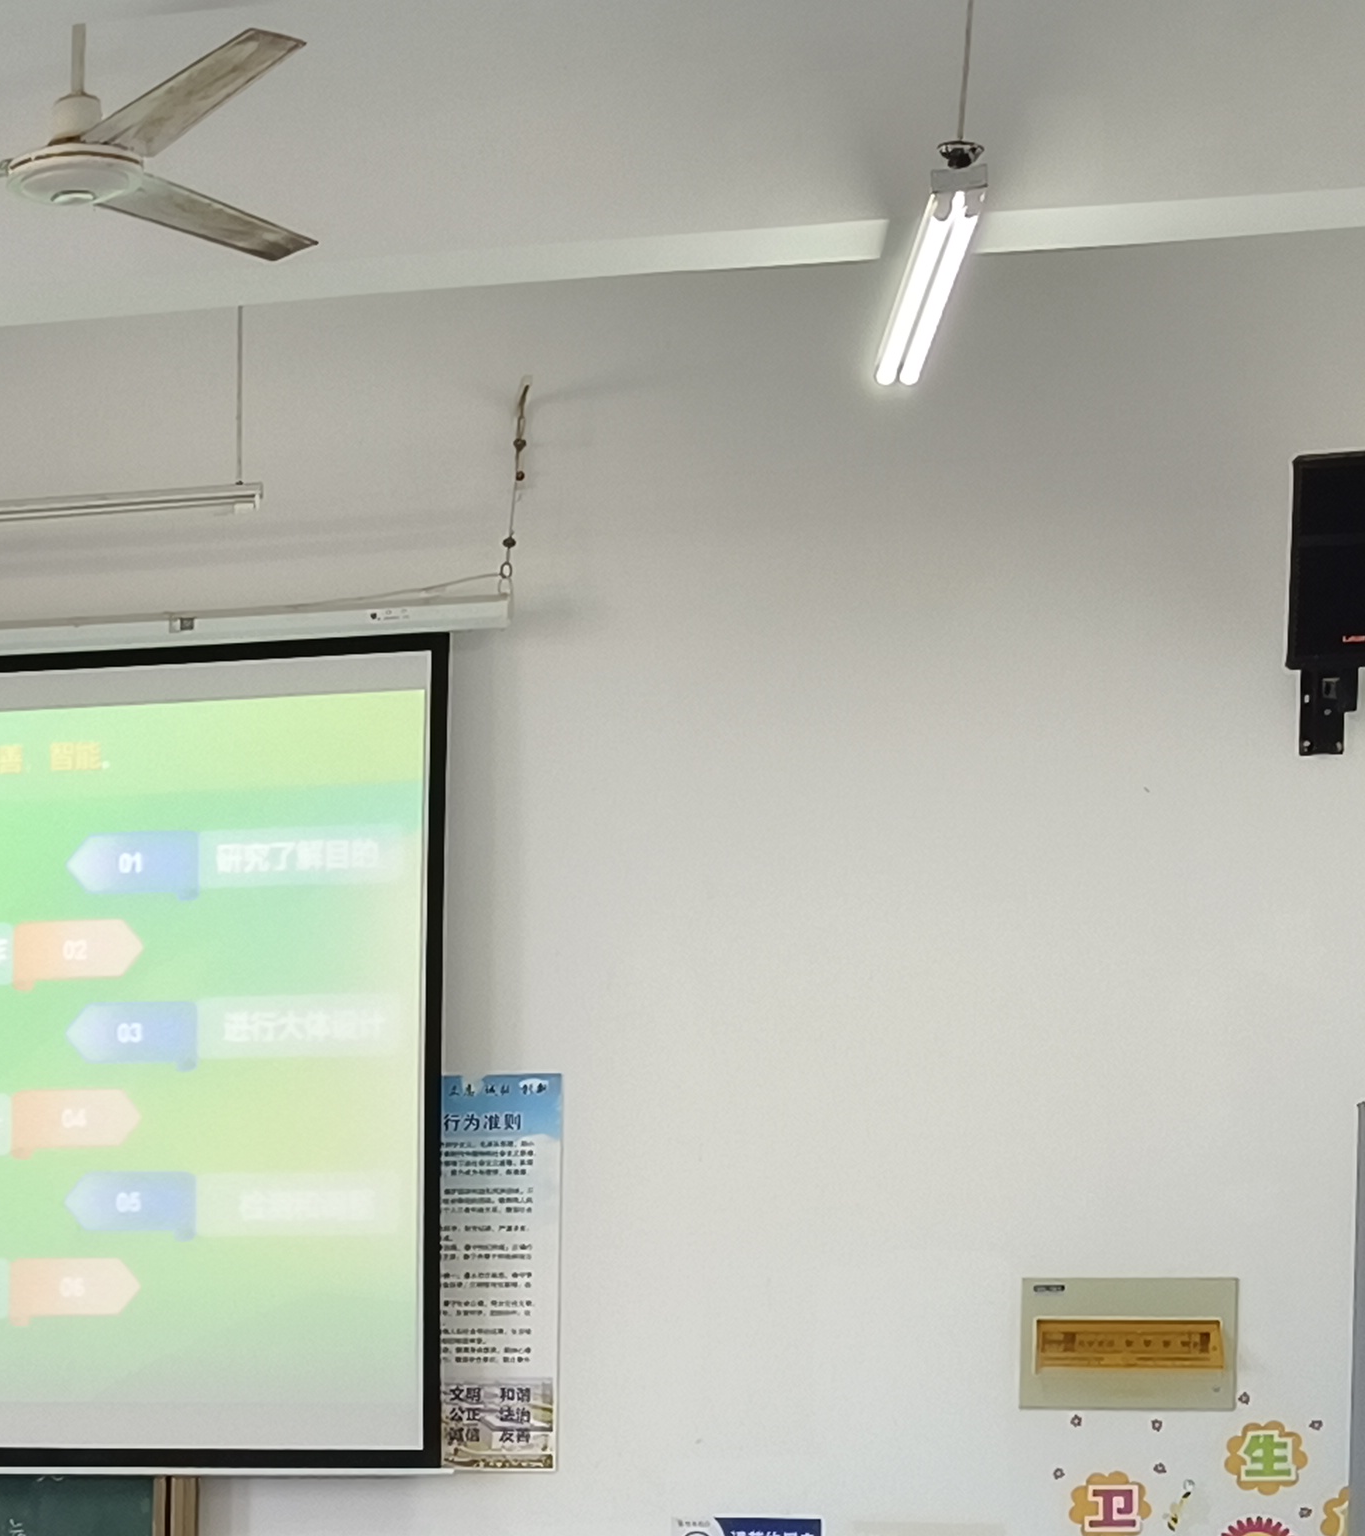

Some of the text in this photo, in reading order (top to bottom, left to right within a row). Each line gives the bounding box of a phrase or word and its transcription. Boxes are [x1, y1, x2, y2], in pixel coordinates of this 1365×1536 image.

[119, 852, 143, 874] 01
[62, 939, 87, 961] 02
[117, 1023, 142, 1044] 03
[443, 1112, 522, 1133] 行为准则
[116, 1192, 141, 1213] 05
[449, 1386, 532, 1403] 文明 和谐
[449, 1406, 531, 1424] 公正 法治
[1244, 1432, 1293, 1478] 生
[1088, 1487, 1139, 1528] 卫
